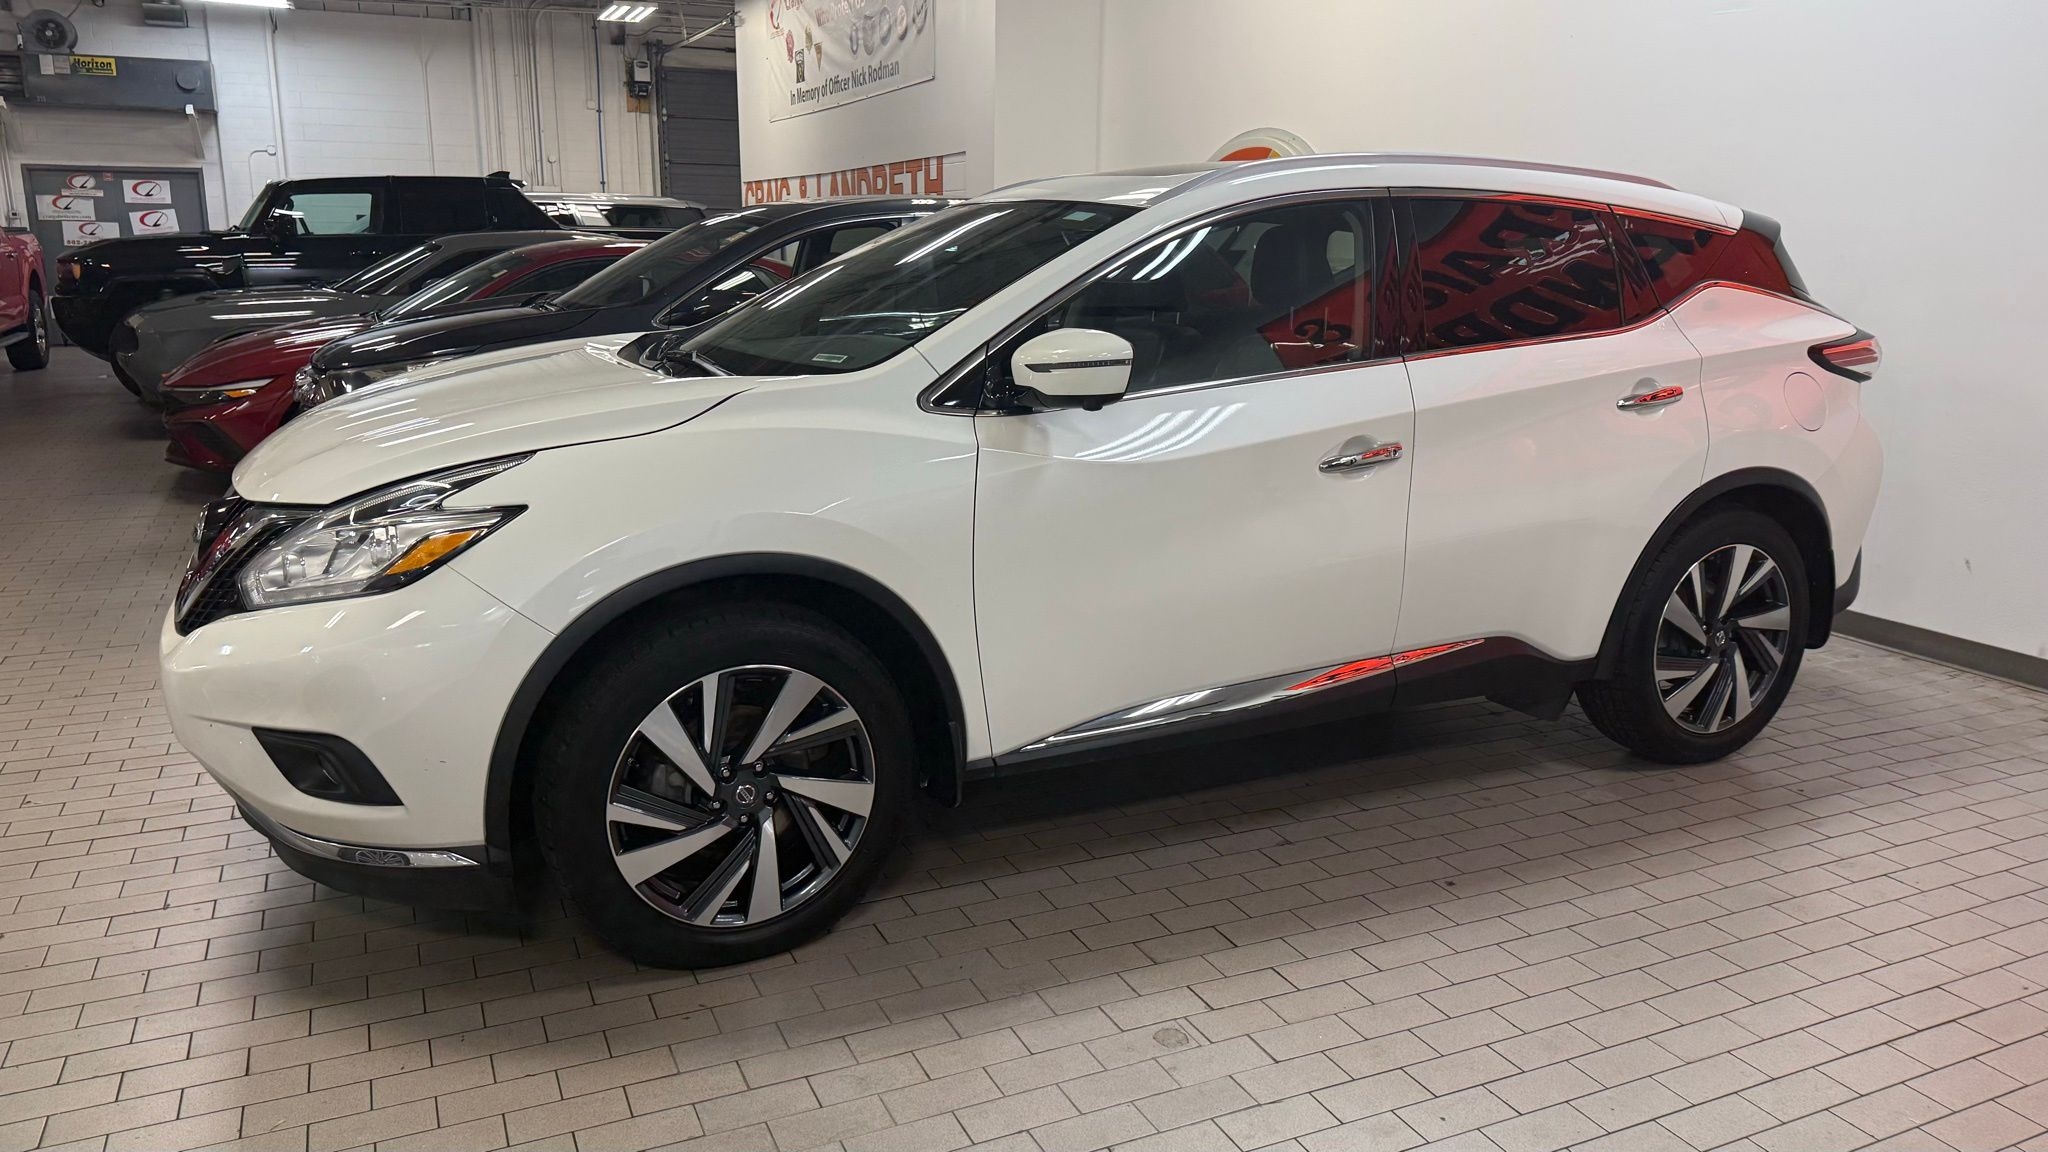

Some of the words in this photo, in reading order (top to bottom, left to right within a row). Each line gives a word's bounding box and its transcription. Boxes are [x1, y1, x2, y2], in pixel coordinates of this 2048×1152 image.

[72, 58, 112, 69] Horizon
[790, 90, 796, 106] In
[796, 86, 820, 103] Memory
[821, 79, 828, 97] of
[828, 75, 850, 95] Officer
[851, 66, 867, 88] Nick
[868, 60, 900, 84] Rodman
